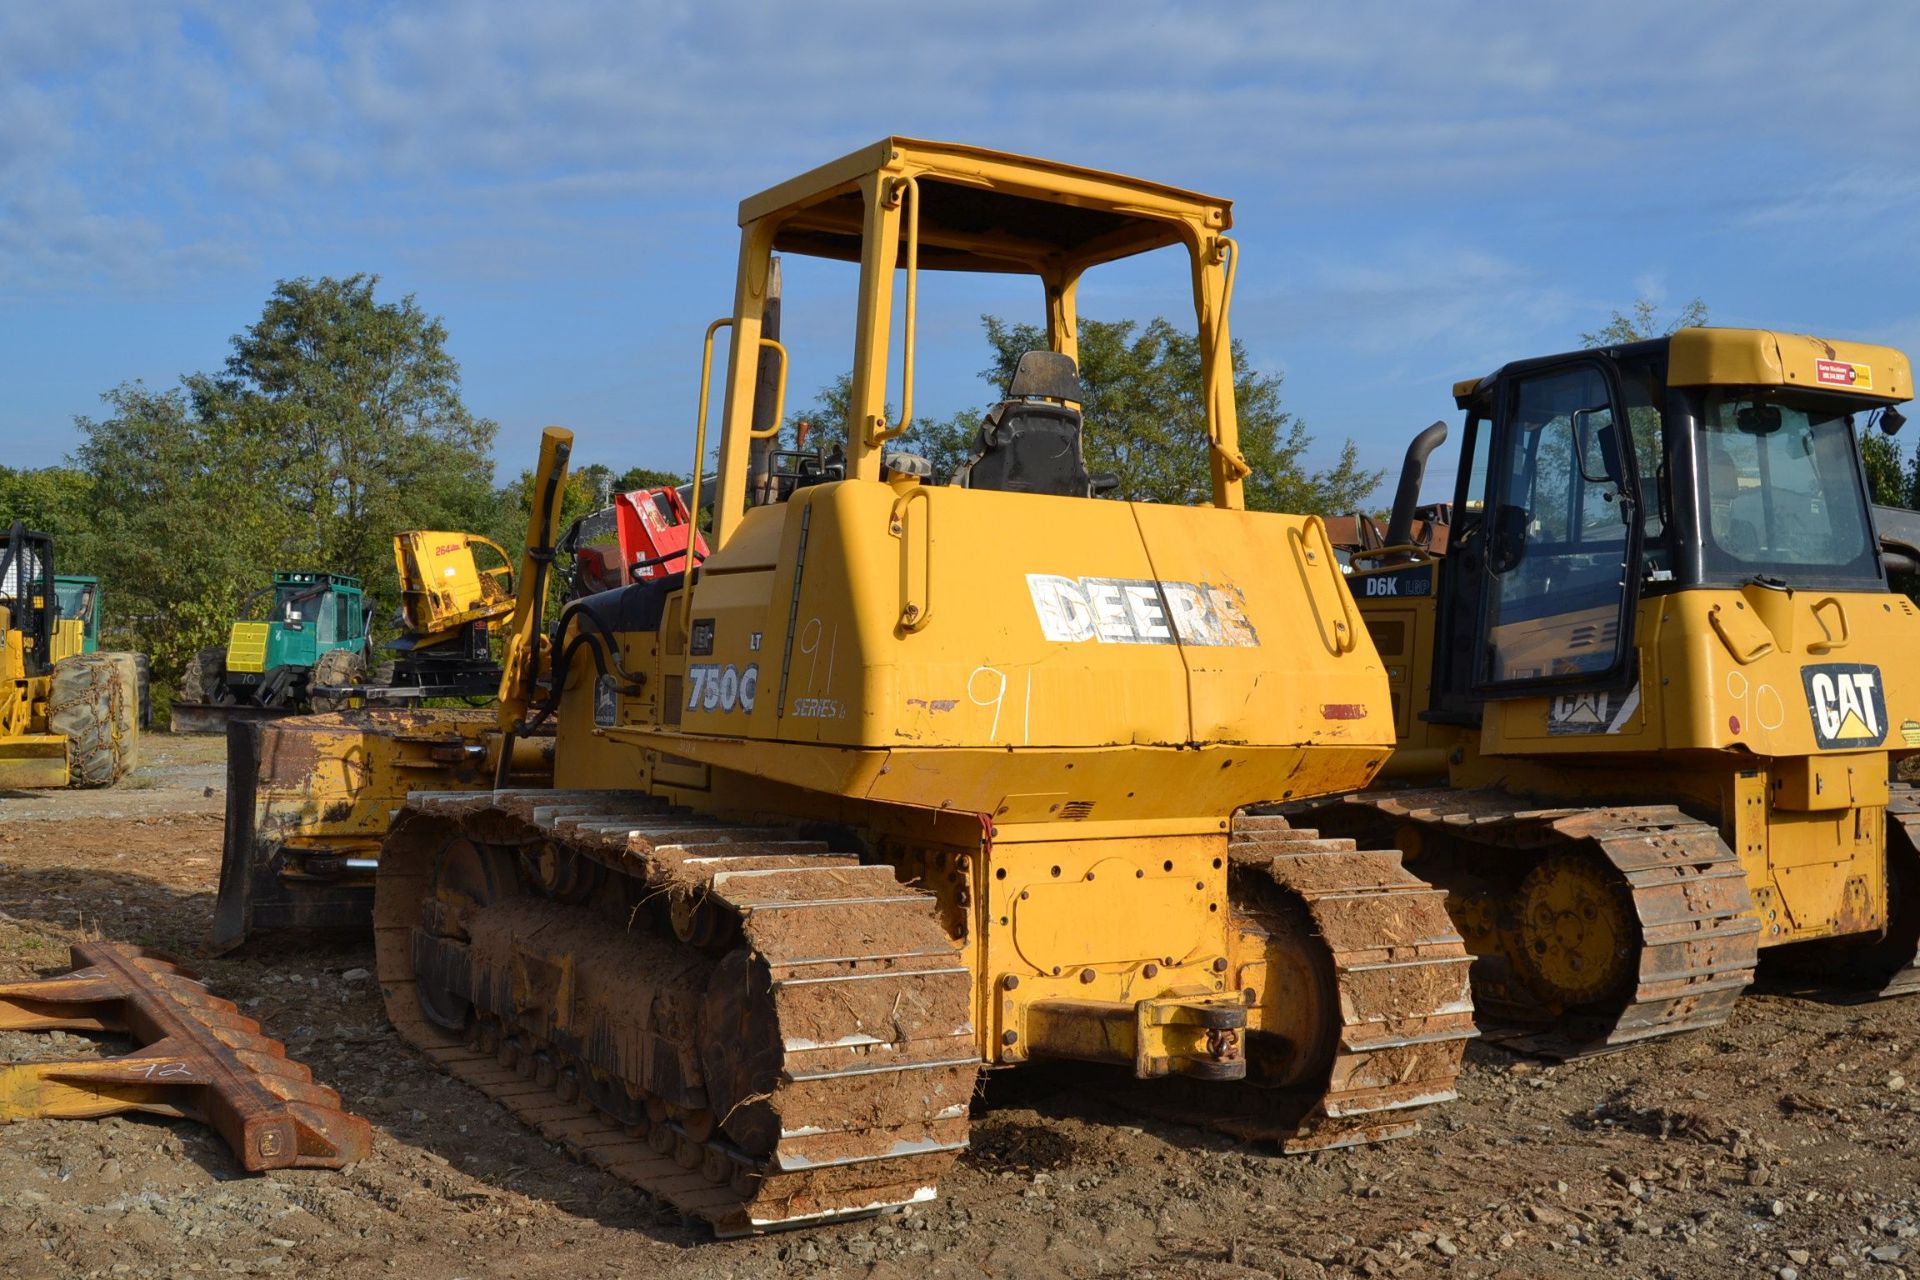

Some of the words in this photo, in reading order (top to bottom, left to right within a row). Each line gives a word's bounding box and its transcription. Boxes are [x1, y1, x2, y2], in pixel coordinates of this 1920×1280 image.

[1366, 577, 1398, 596] D6K
[1025, 574, 1260, 648] DEERE
[751, 633, 763, 650] LT
[800, 617, 838, 695] 91
[240, 673, 256, 685] 70
[792, 698, 836, 718] SERIES
[967, 664, 1031, 746] 91
[1727, 671, 1785, 733] 90
[1812, 673, 1882, 740] CAT
[128, 1063, 192, 1078] 92
